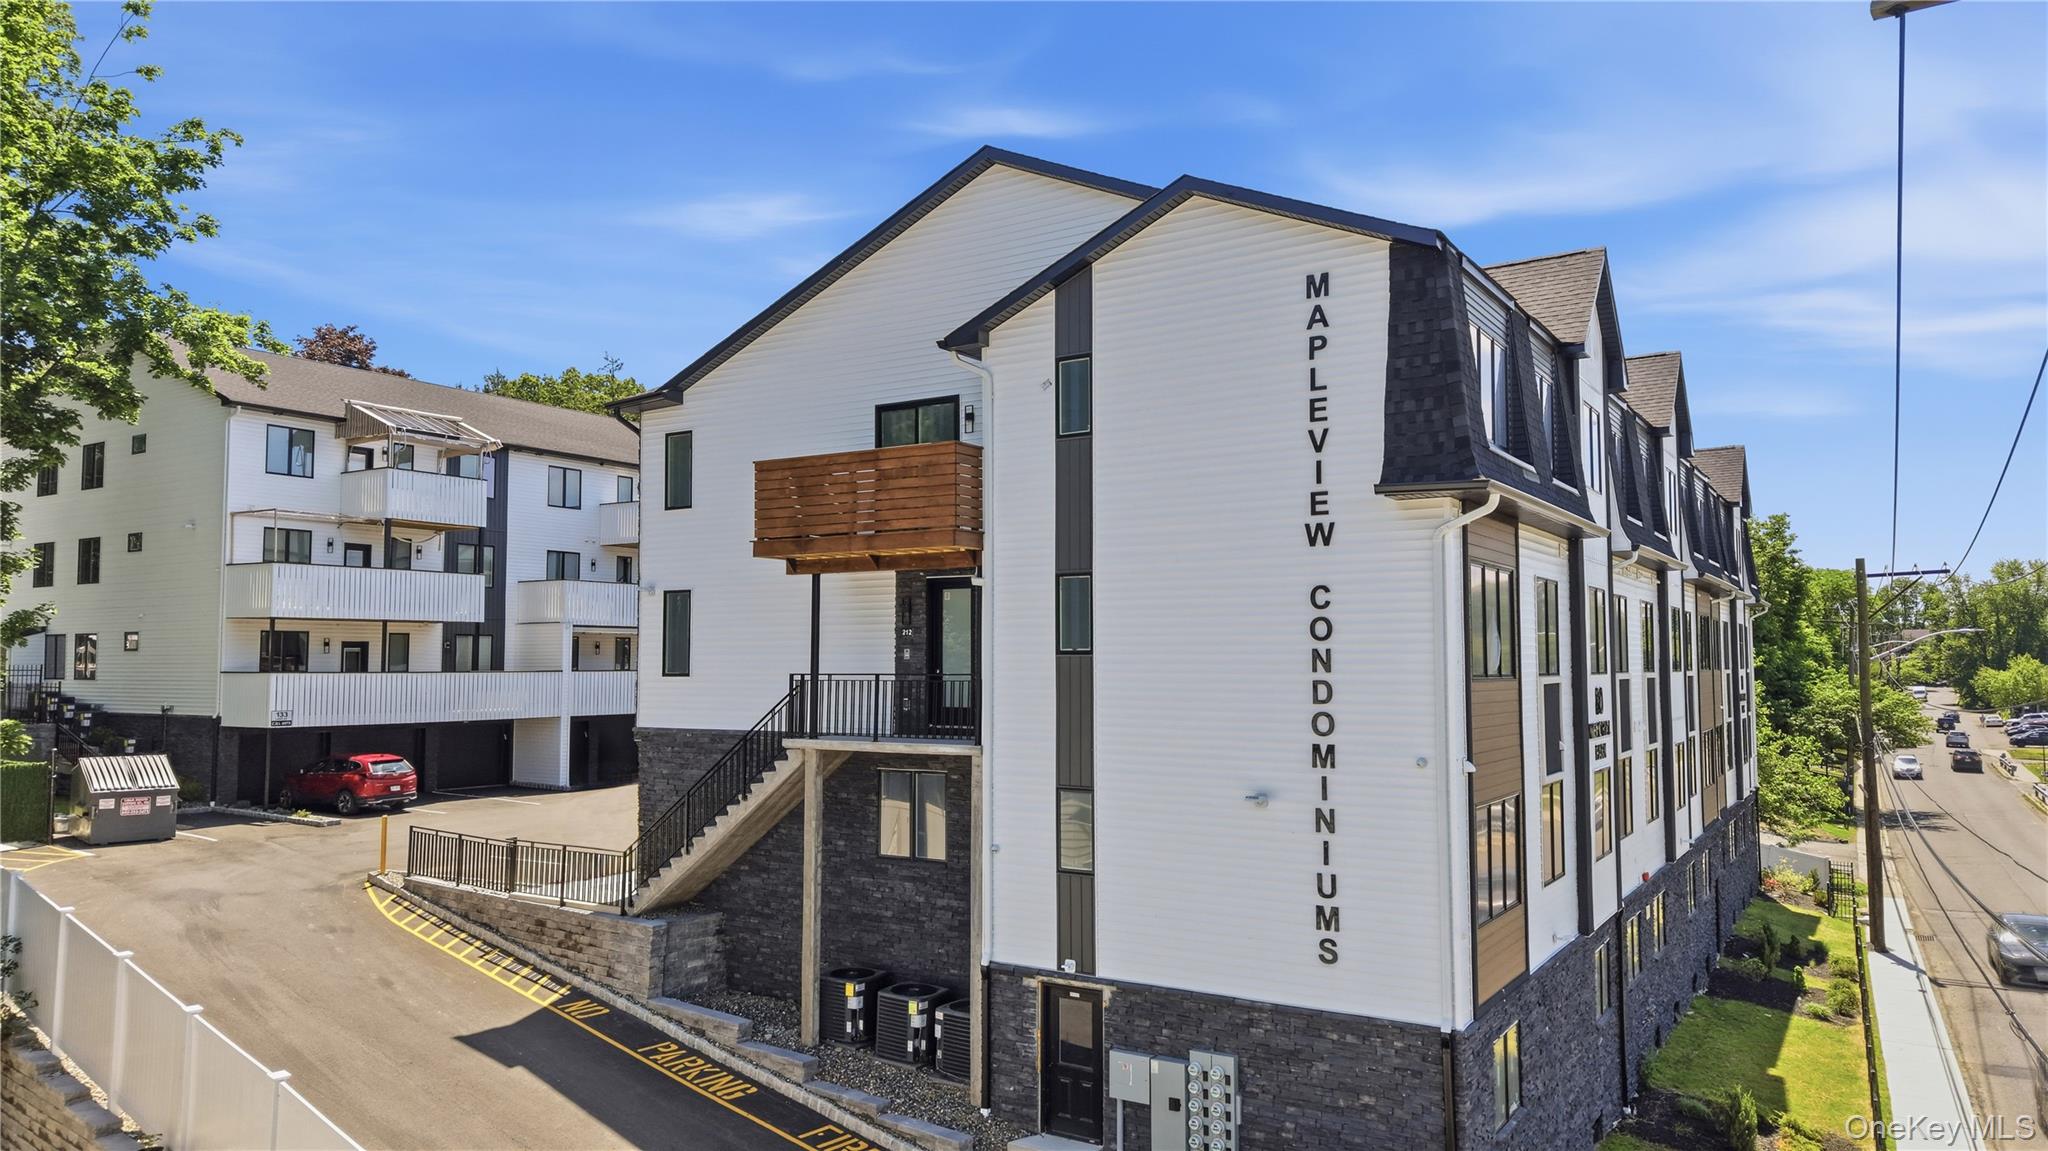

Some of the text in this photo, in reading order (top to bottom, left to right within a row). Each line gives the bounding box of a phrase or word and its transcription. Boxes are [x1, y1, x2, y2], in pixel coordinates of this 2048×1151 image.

[1304, 272, 1341, 965] MAPLEVIEW CONDOMINIUMS
[557, 999, 881, 1151] NO PARKING FIR
